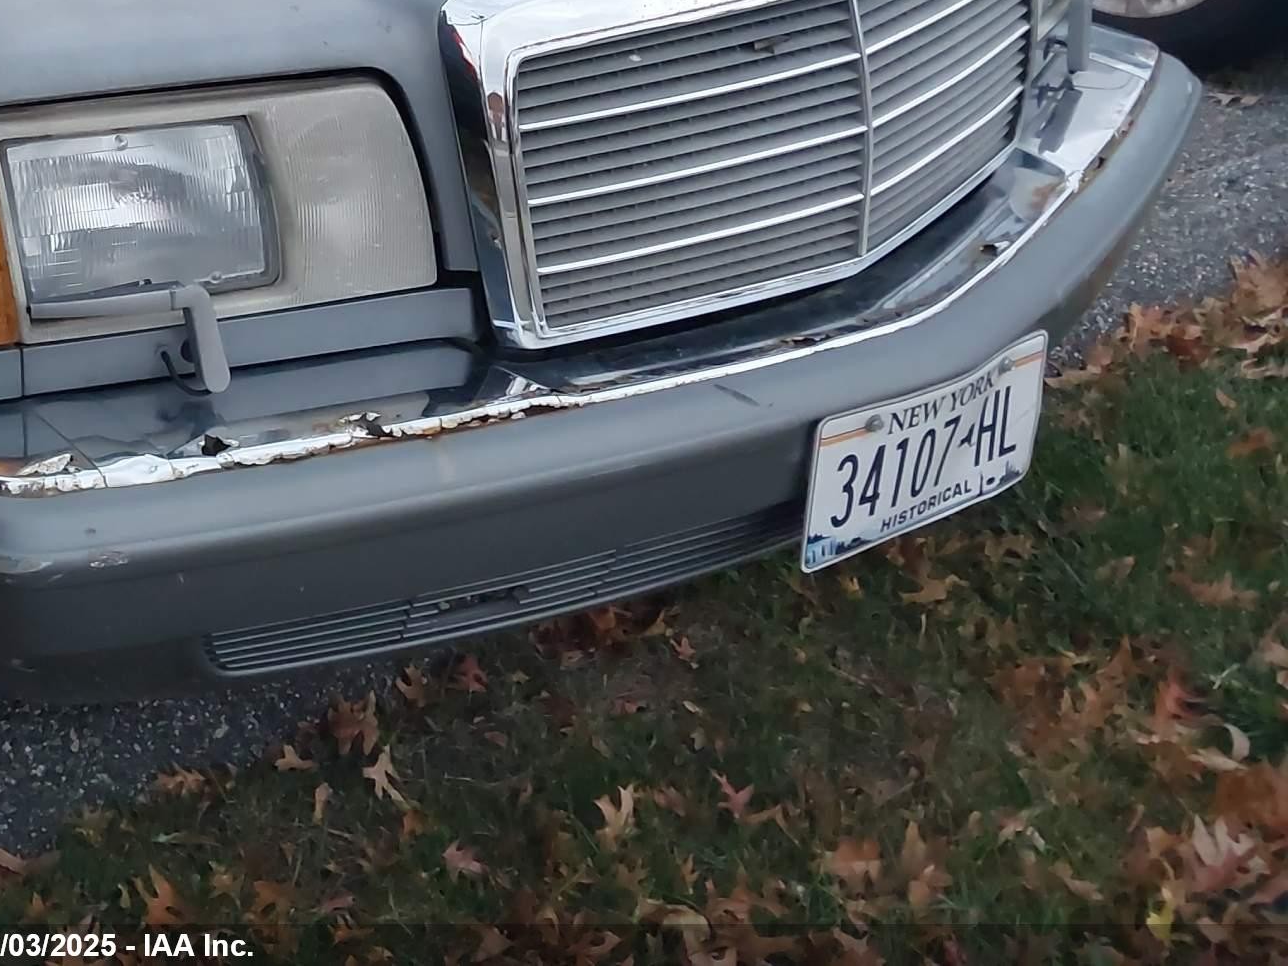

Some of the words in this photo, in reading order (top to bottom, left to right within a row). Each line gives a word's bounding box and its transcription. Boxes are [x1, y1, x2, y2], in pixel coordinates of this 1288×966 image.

[887, 398, 944, 435] NEW
[951, 372, 994, 412] YORK
[879, 480, 972, 533] HISTORICAL
